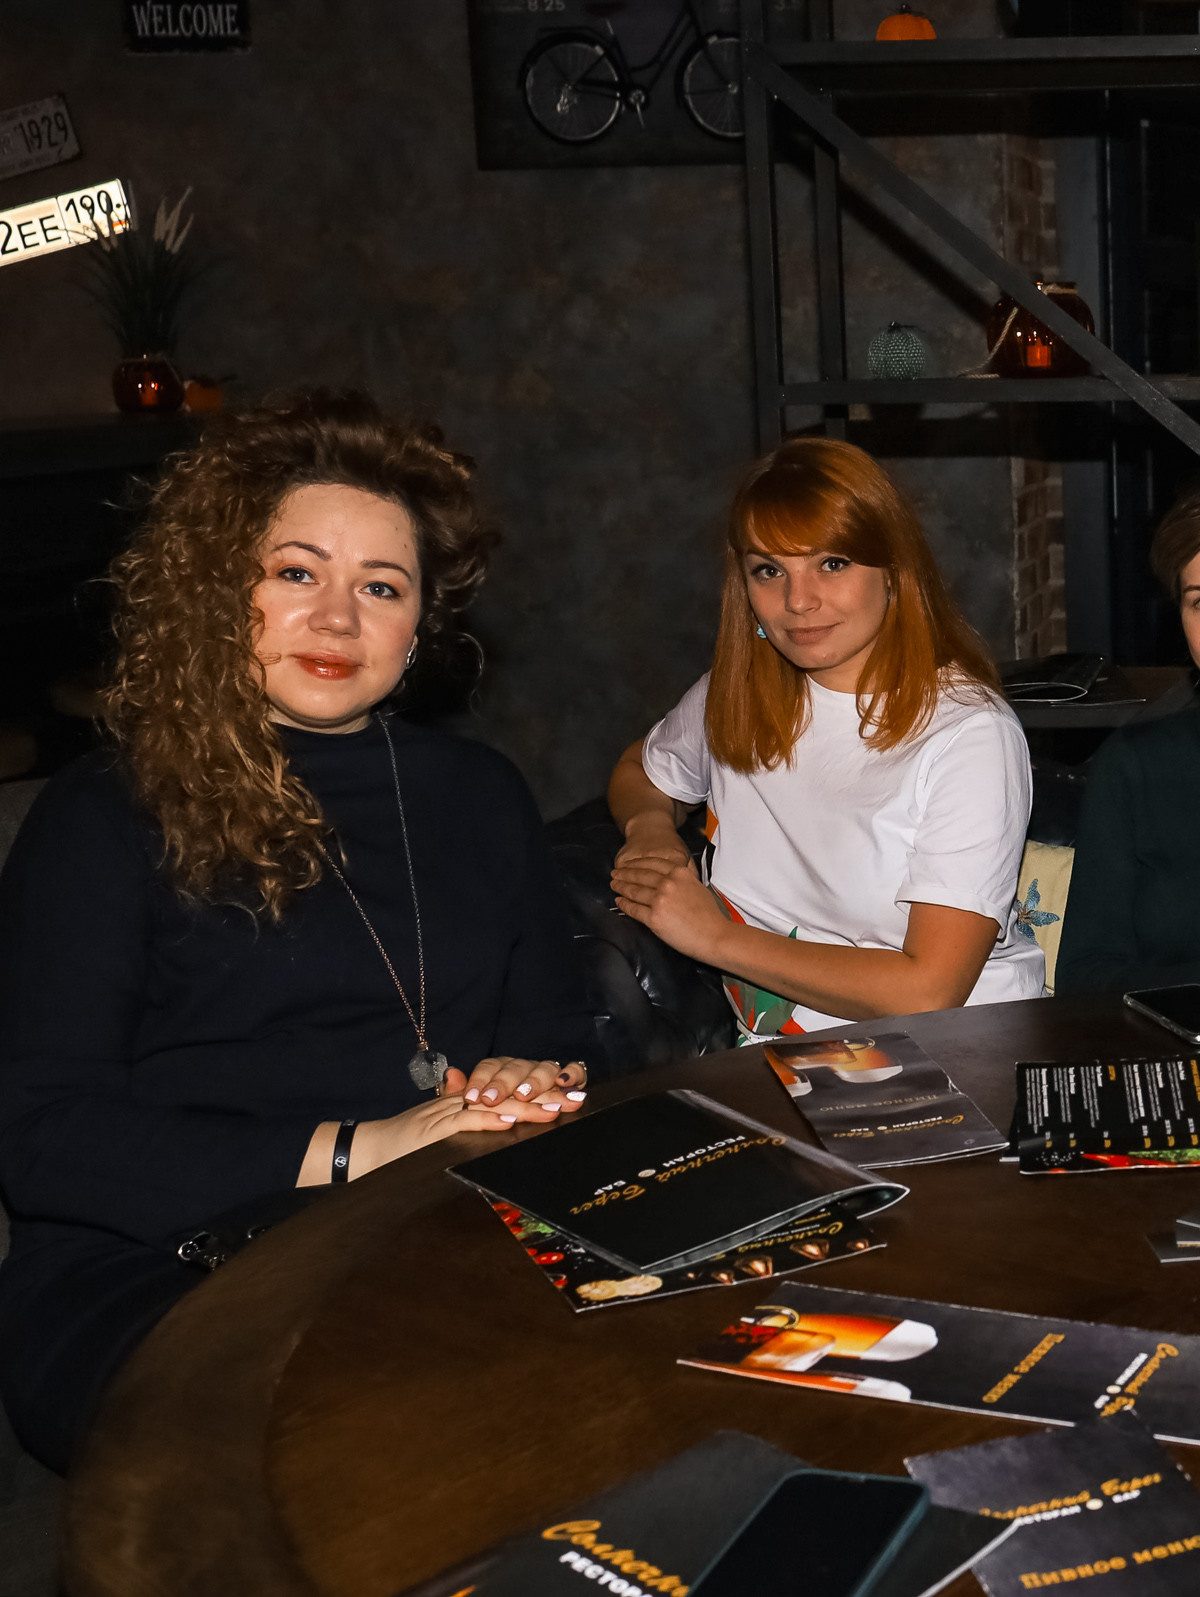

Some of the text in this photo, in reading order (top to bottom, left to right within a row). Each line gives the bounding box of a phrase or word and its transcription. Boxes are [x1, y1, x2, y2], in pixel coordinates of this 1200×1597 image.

[132, 0, 240, 37] WELCOME
[16, 112, 68, 153] 1929
[569, 1134, 787, 1214] Солнечный Берег
[594, 1135, 746, 1196] РЕСТОРАН БАР
[1101, 1472, 1163, 1497] Берег
[1014, 1489, 1142, 1527] ЕСТОРАН БАР
[559, 1550, 652, 1597] РЕСТОР
[1020, 1556, 1125, 1591] Пивное
